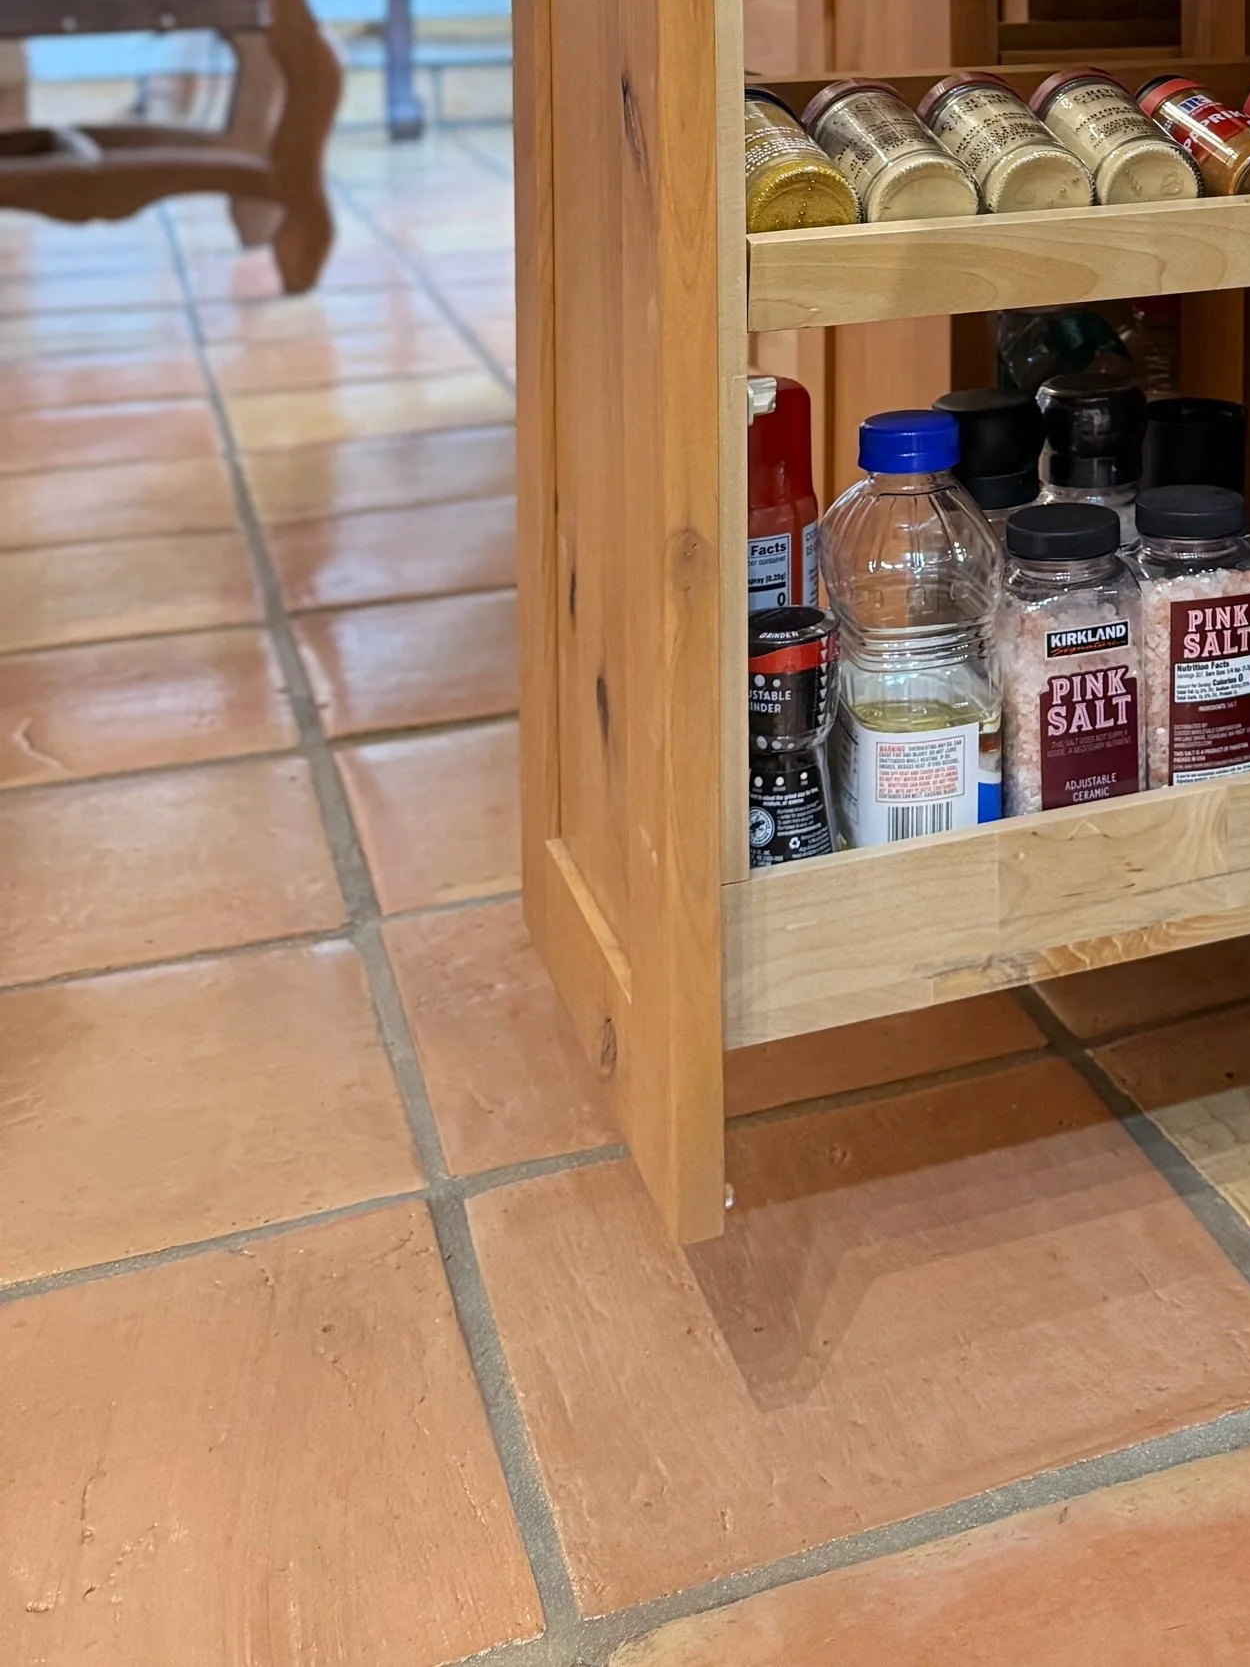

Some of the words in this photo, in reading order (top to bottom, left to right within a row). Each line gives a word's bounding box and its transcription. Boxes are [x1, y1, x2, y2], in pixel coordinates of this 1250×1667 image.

[751, 542, 787, 556] Facts
[777, 592, 786, 607] 0
[1187, 603, 1249, 632] PINK
[759, 631, 799, 639] GRINDER
[1050, 624, 1127, 648] KIRKLAND
[1176, 663, 1209, 672] Nutrition
[1211, 661, 1230, 669] Facts
[1051, 667, 1127, 705] PINK
[1212, 677, 1236, 686] Calories
[1238, 673, 1244, 682] 0
[748, 690, 792, 701] USTABLE
[749, 702, 782, 714] INDER
[1047, 694, 1132, 736] SALT
[1065, 773, 1117, 791] ADJUSTABLE
[1072, 787, 1110, 802] CERAMIC
